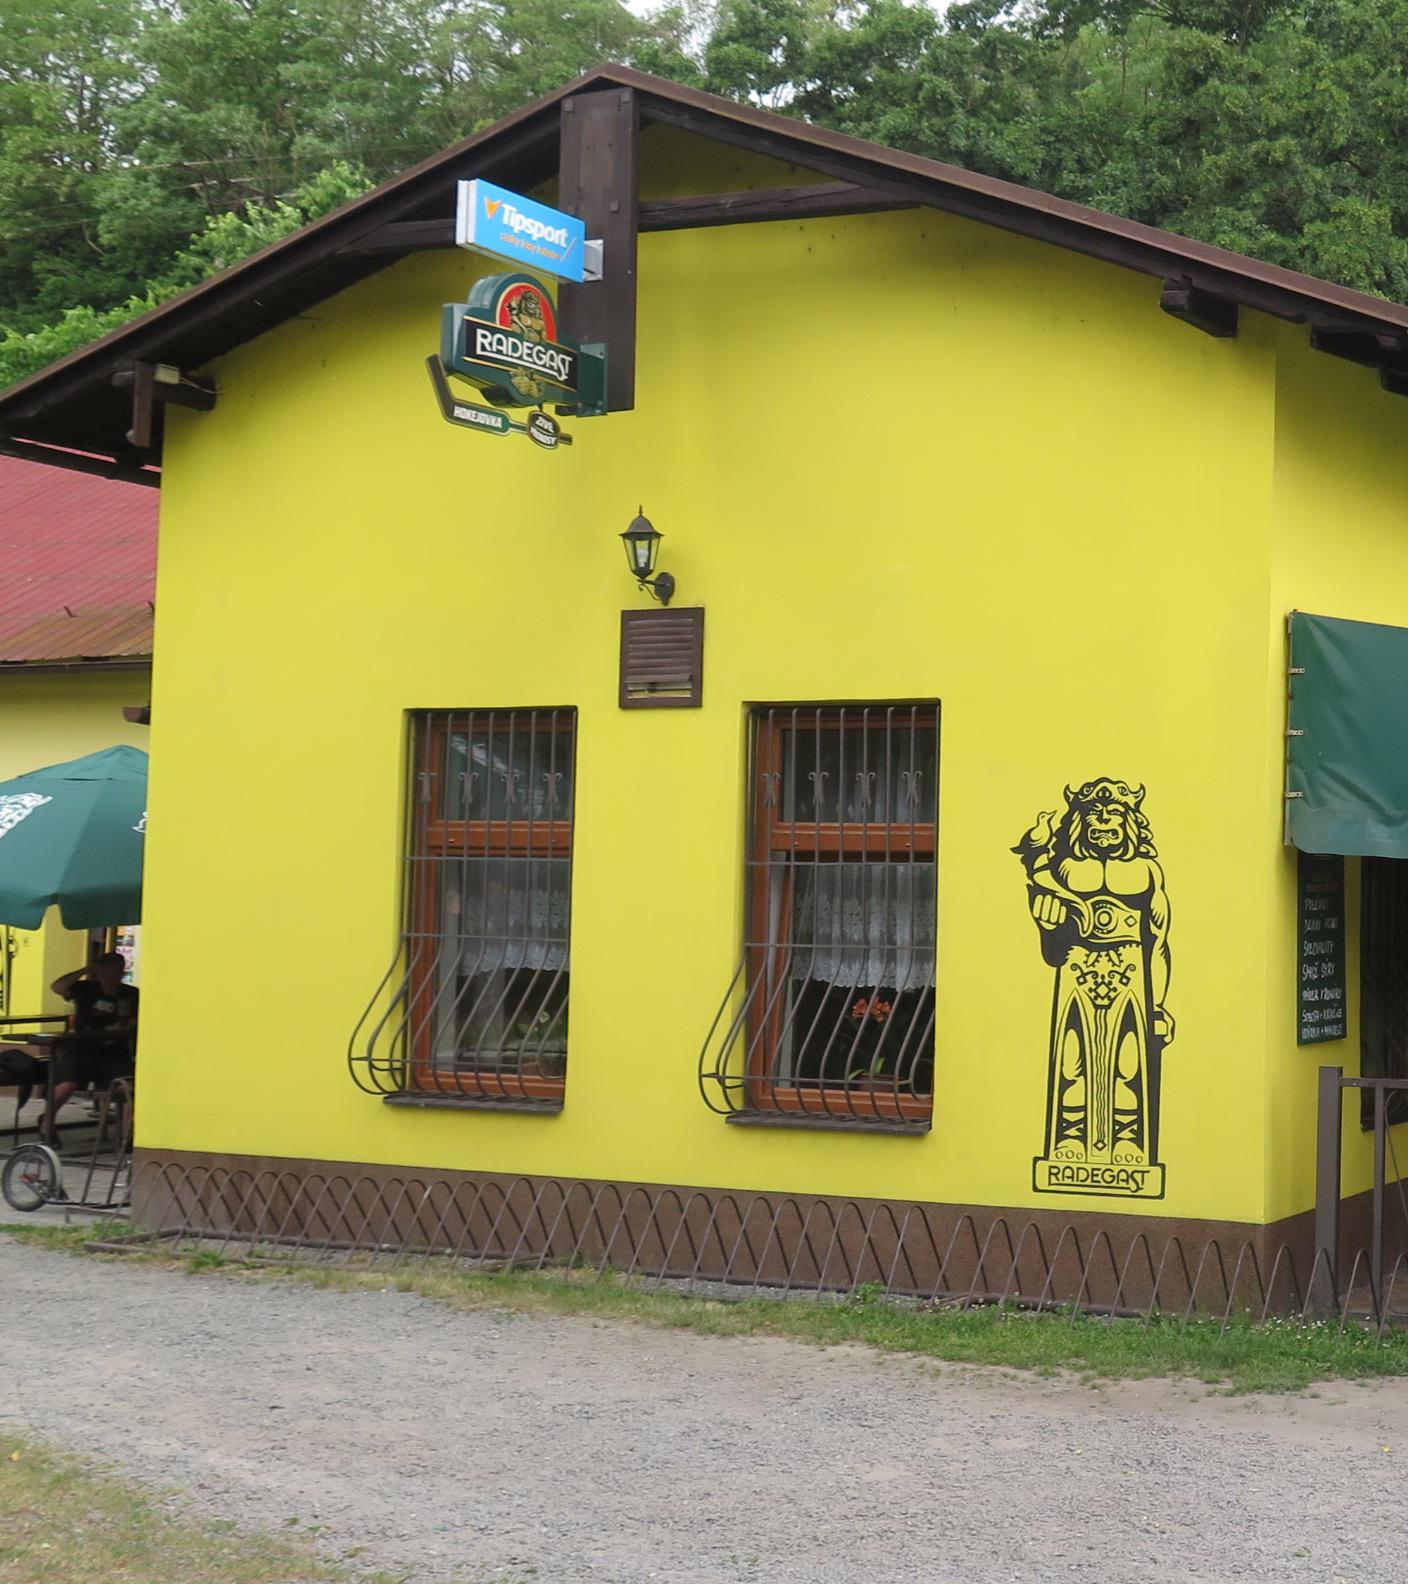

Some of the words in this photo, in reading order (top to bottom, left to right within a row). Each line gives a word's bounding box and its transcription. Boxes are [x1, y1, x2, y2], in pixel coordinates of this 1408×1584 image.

[502, 203, 569, 248] Tipsport
[475, 328, 573, 382] RADEGAST
[453, 405, 503, 429] HOKEJOVKA
[1048, 1165, 1150, 1193] RADEGAST
